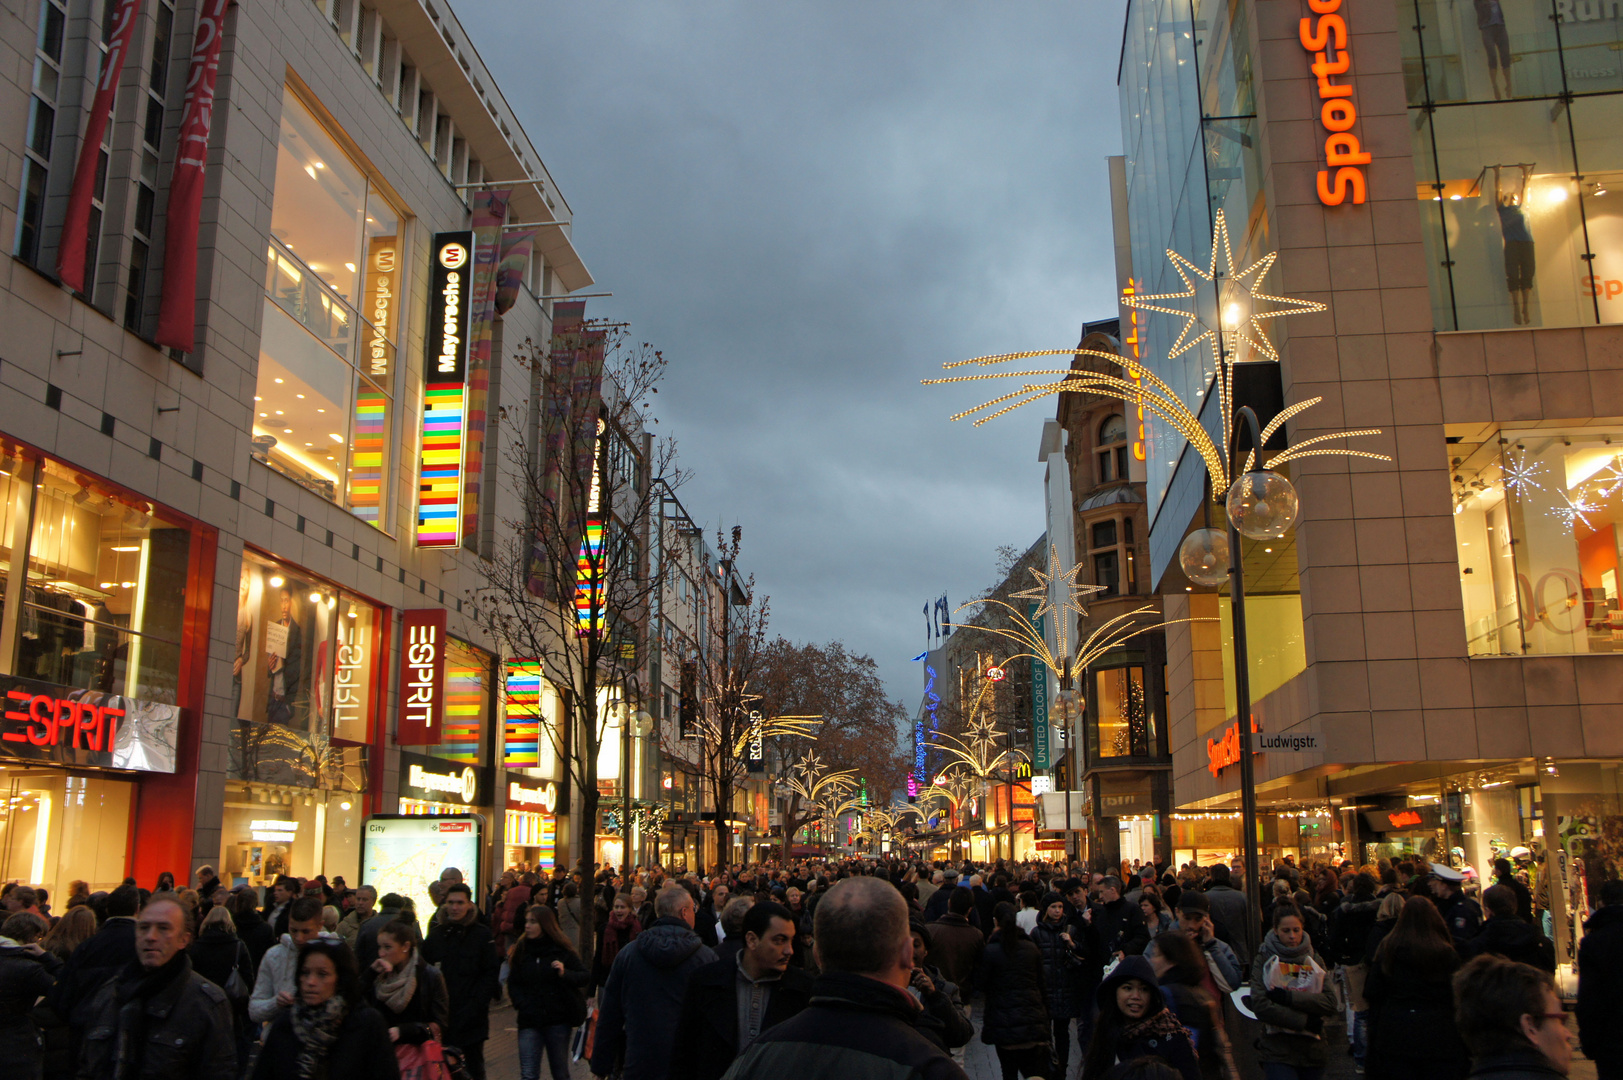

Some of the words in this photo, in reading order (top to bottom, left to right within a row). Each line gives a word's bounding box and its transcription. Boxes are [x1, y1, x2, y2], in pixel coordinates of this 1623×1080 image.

[438, 271, 459, 372] Mayersche
[406, 625, 436, 728] ESPRIT
[1034, 668, 1043, 682] OF
[2, 690, 126, 753] ESPRIT
[1034, 683, 1045, 723] COLORS
[1036, 727, 1046, 763] UNITED
[1260, 735, 1317, 751] Ludwigstr.
[369, 824, 386, 833] City
